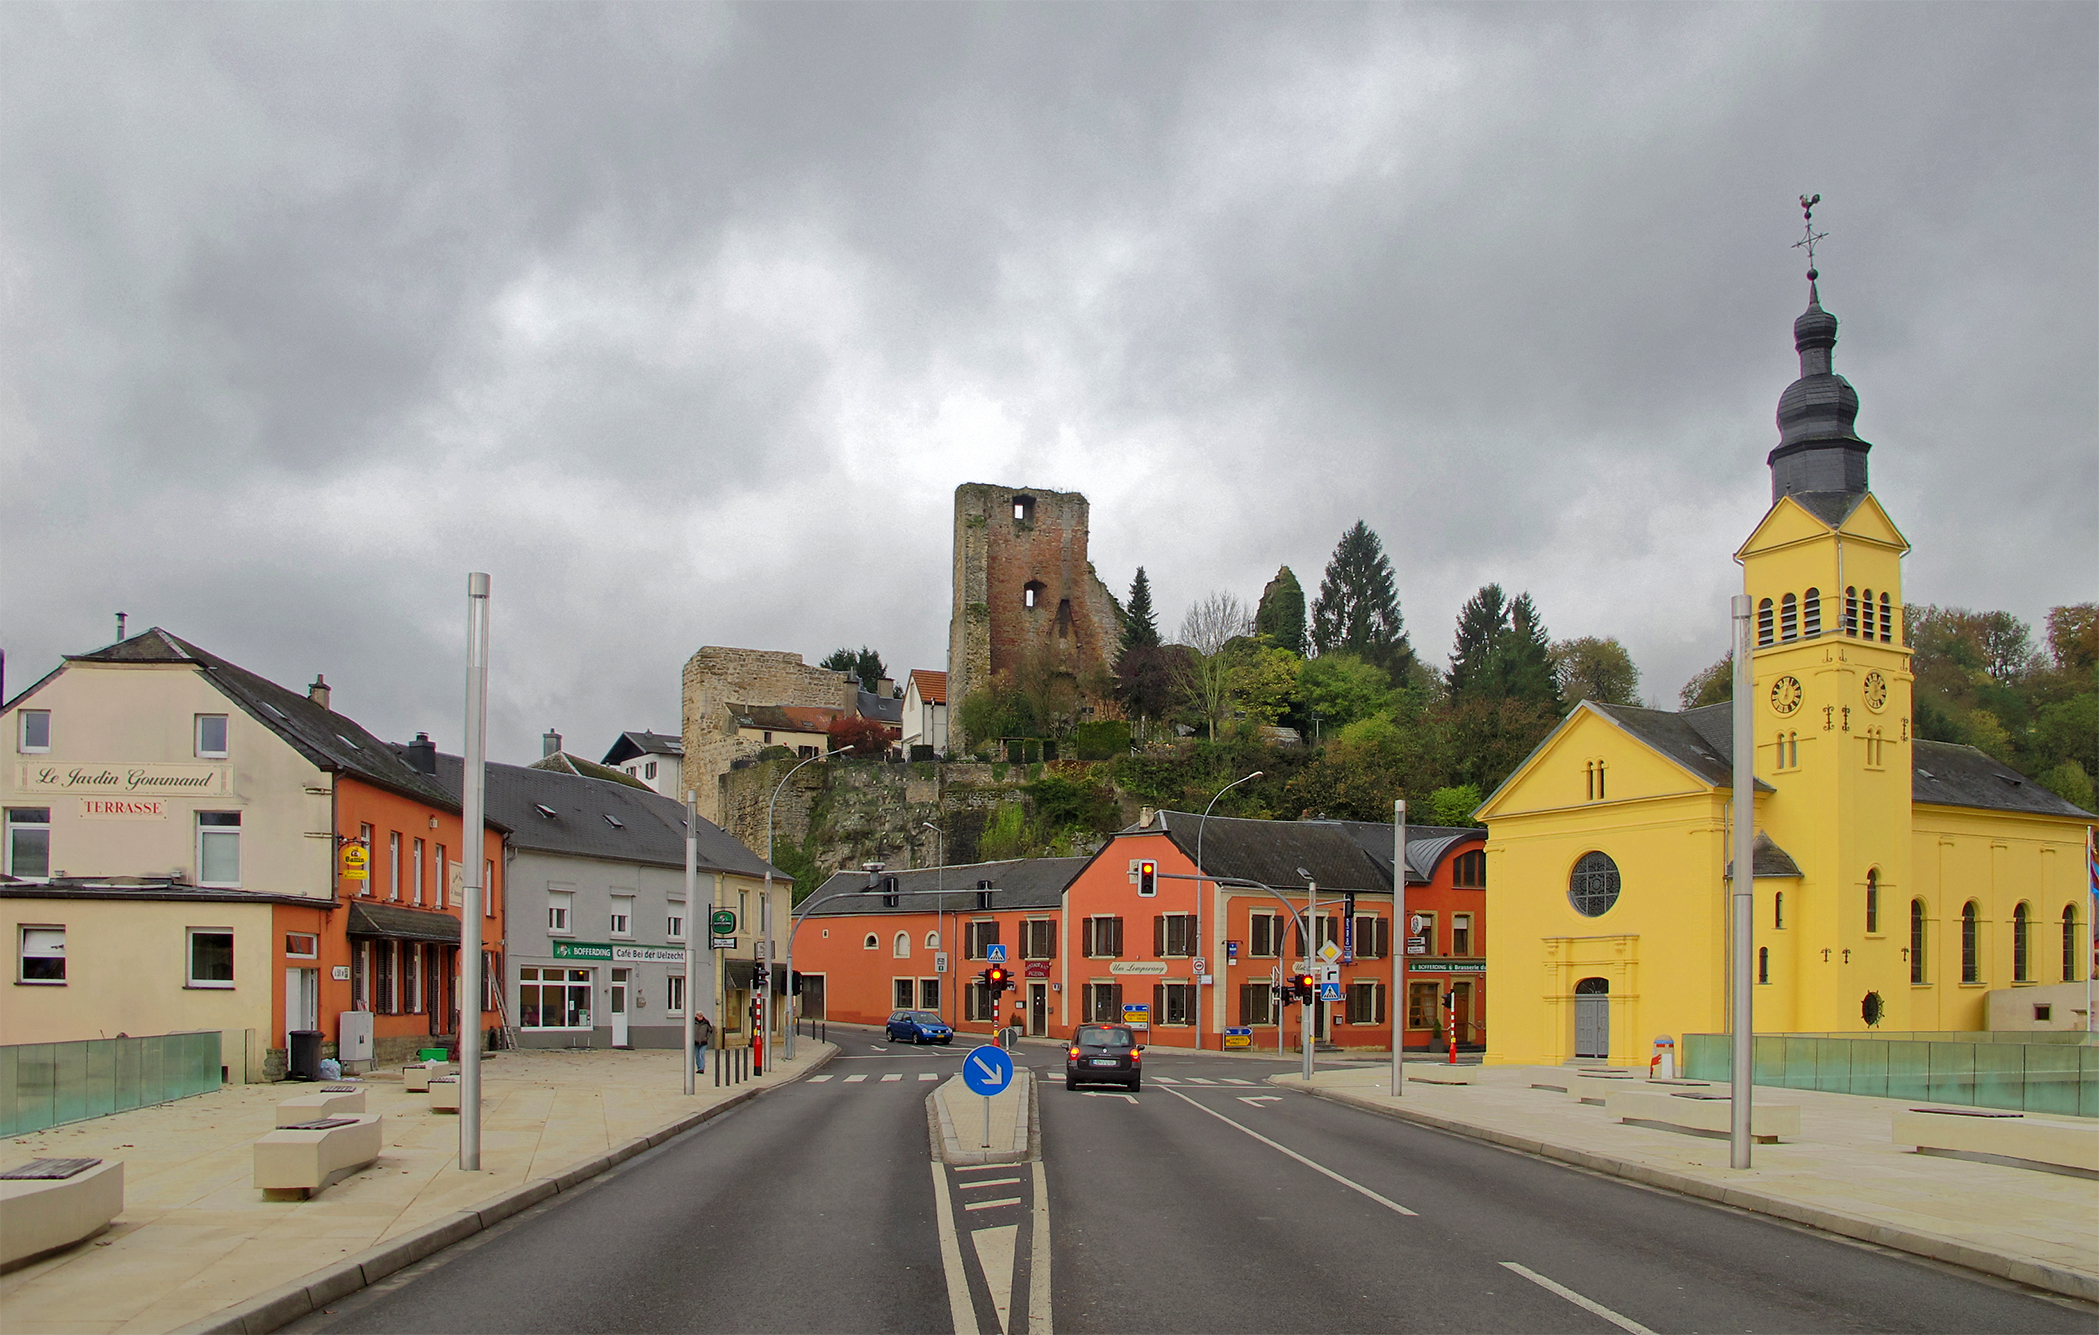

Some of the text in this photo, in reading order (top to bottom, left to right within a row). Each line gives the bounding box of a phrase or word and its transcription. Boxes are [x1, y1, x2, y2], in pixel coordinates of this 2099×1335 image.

[36, 767, 214, 791] Le Jardin Gourmand
[84, 801, 162, 814] TERRASSE
[573, 947, 611, 957] BOFFERDING
[633, 949, 643, 958] Bei
[644, 950, 655, 959] der
